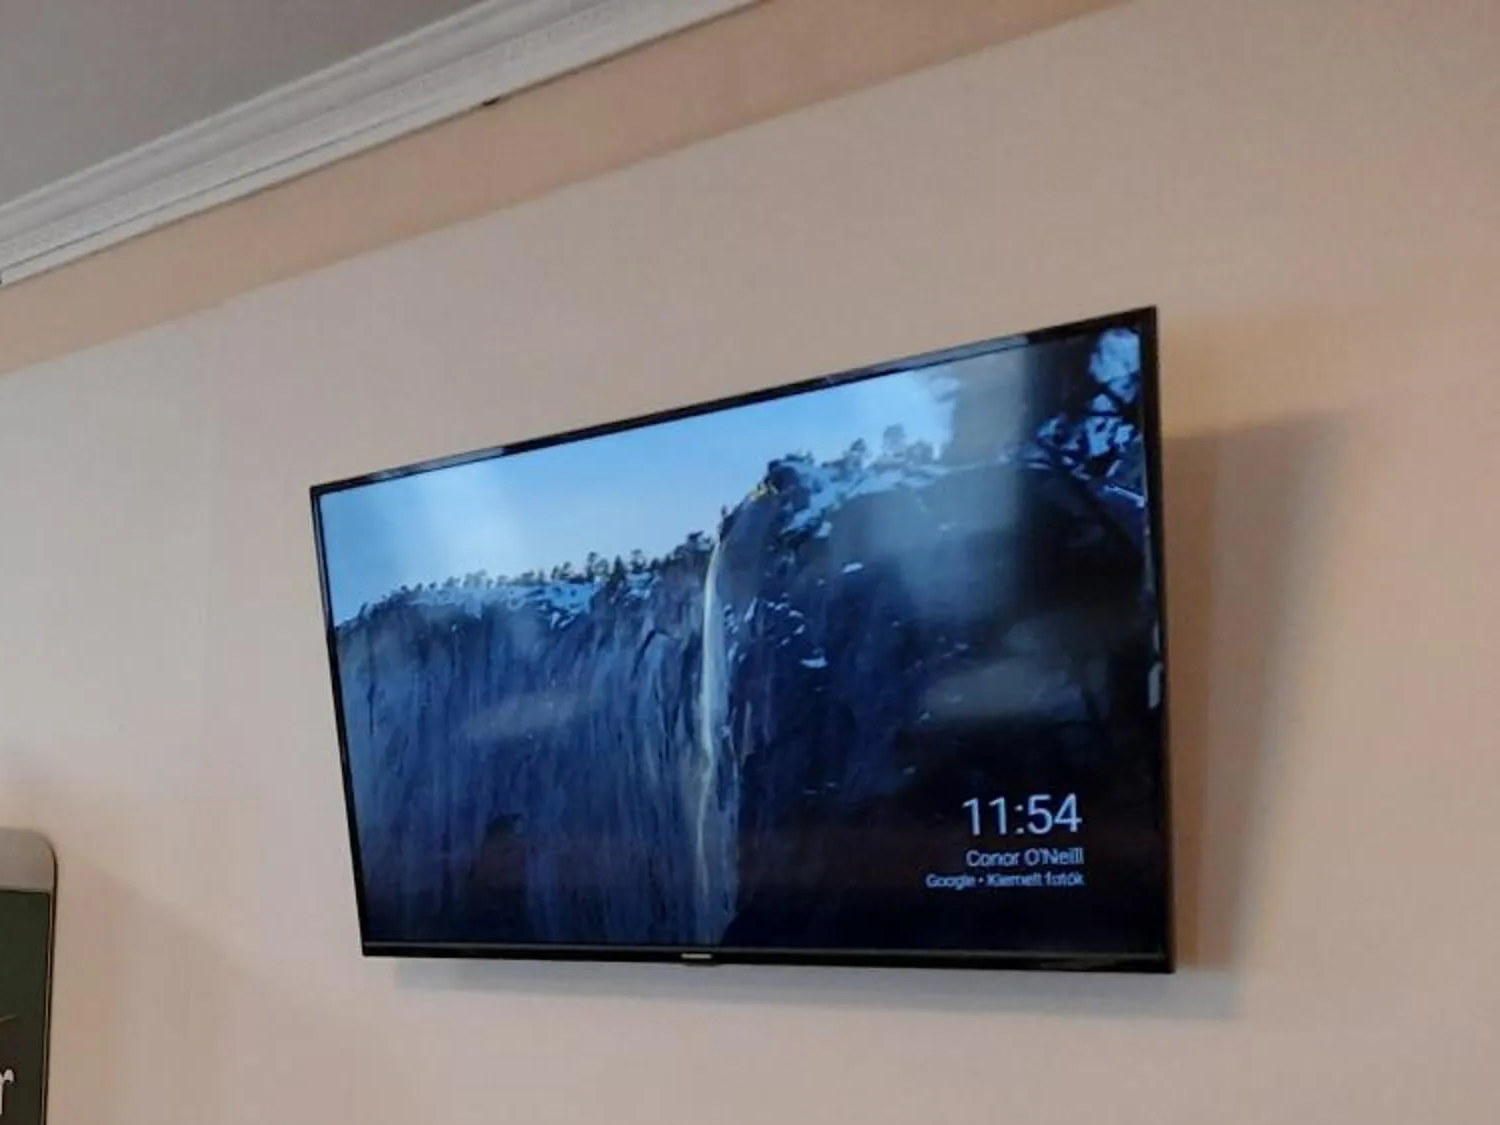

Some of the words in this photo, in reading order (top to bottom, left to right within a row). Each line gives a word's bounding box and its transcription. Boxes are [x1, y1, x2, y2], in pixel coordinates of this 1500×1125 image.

[962, 793, 1082, 836] 11:54
[966, 849, 1021, 867] Conor
[925, 873, 976, 890] Google
